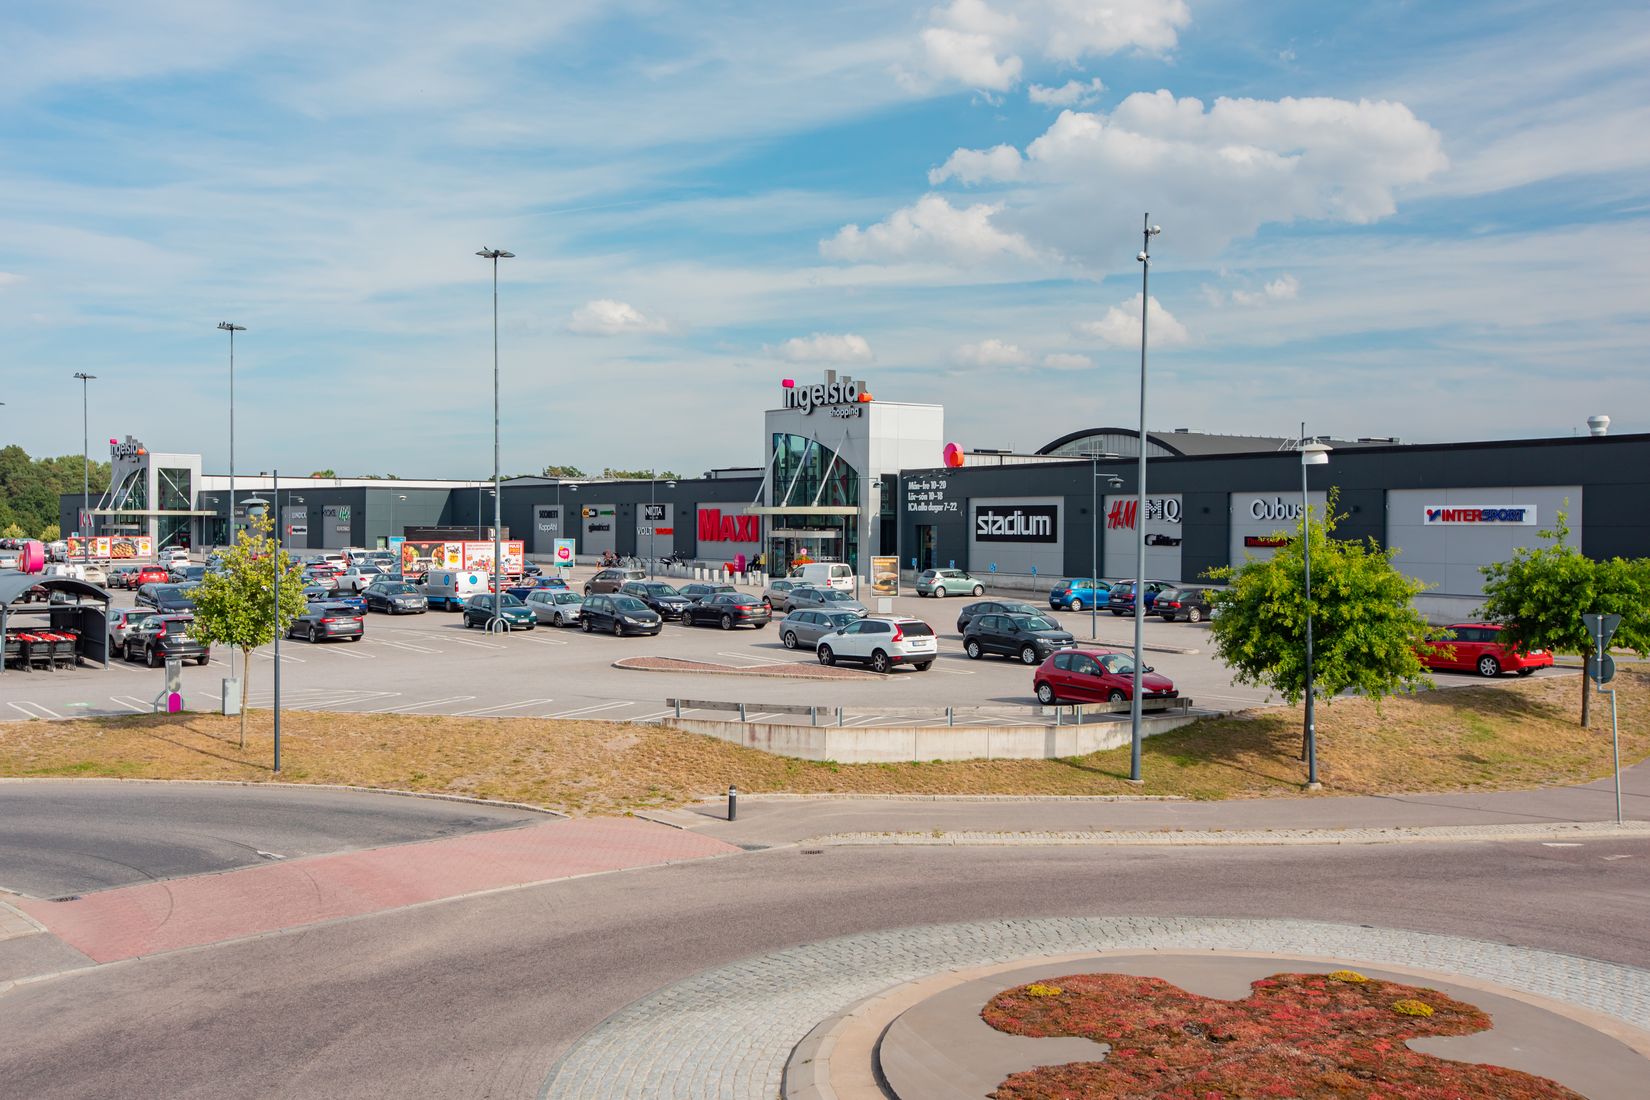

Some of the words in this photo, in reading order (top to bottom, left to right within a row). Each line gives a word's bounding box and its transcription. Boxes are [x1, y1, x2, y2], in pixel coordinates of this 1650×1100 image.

[782, 370, 863, 415] ingelsta
[930, 480, 947, 490] 10-20
[907, 502, 918, 512] ICA
[918, 501, 928, 512] alla
[928, 501, 944, 514] dagar
[944, 502, 958, 512] 7-22
[1107, 499, 1138, 531] H&M
[1144, 499, 1182, 524] MQ
[1249, 496, 1304, 520] Cubus
[1441, 508, 1527, 523] INTERSPORT
[538, 523, 558, 533] KappAhl
[636, 526, 653, 536] VOLT
[698, 508, 760, 543] MAXI
[976, 510, 1053, 536] stadium
